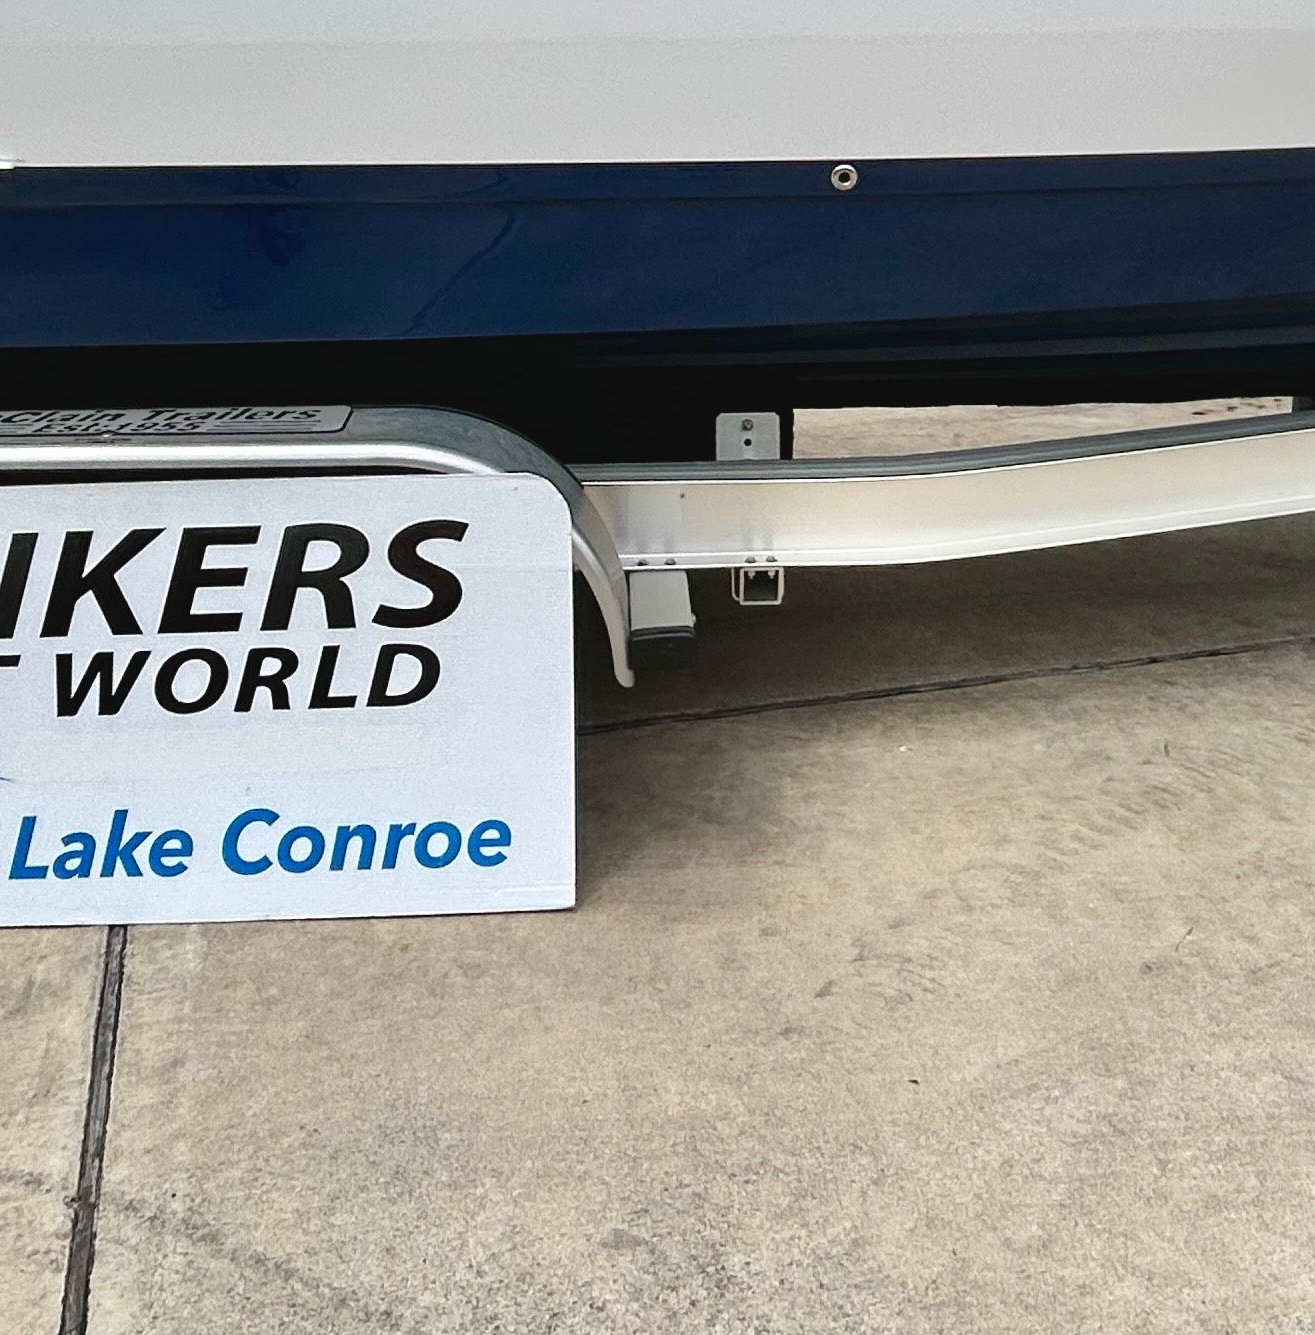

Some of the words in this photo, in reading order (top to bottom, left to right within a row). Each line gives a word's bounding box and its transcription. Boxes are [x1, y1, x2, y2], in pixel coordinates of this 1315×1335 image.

[140, 407, 322, 421] Trailers
[55, 643, 442, 718] WORLD
[9, 810, 194, 880] Lake
[221, 807, 513, 876] Conroe
